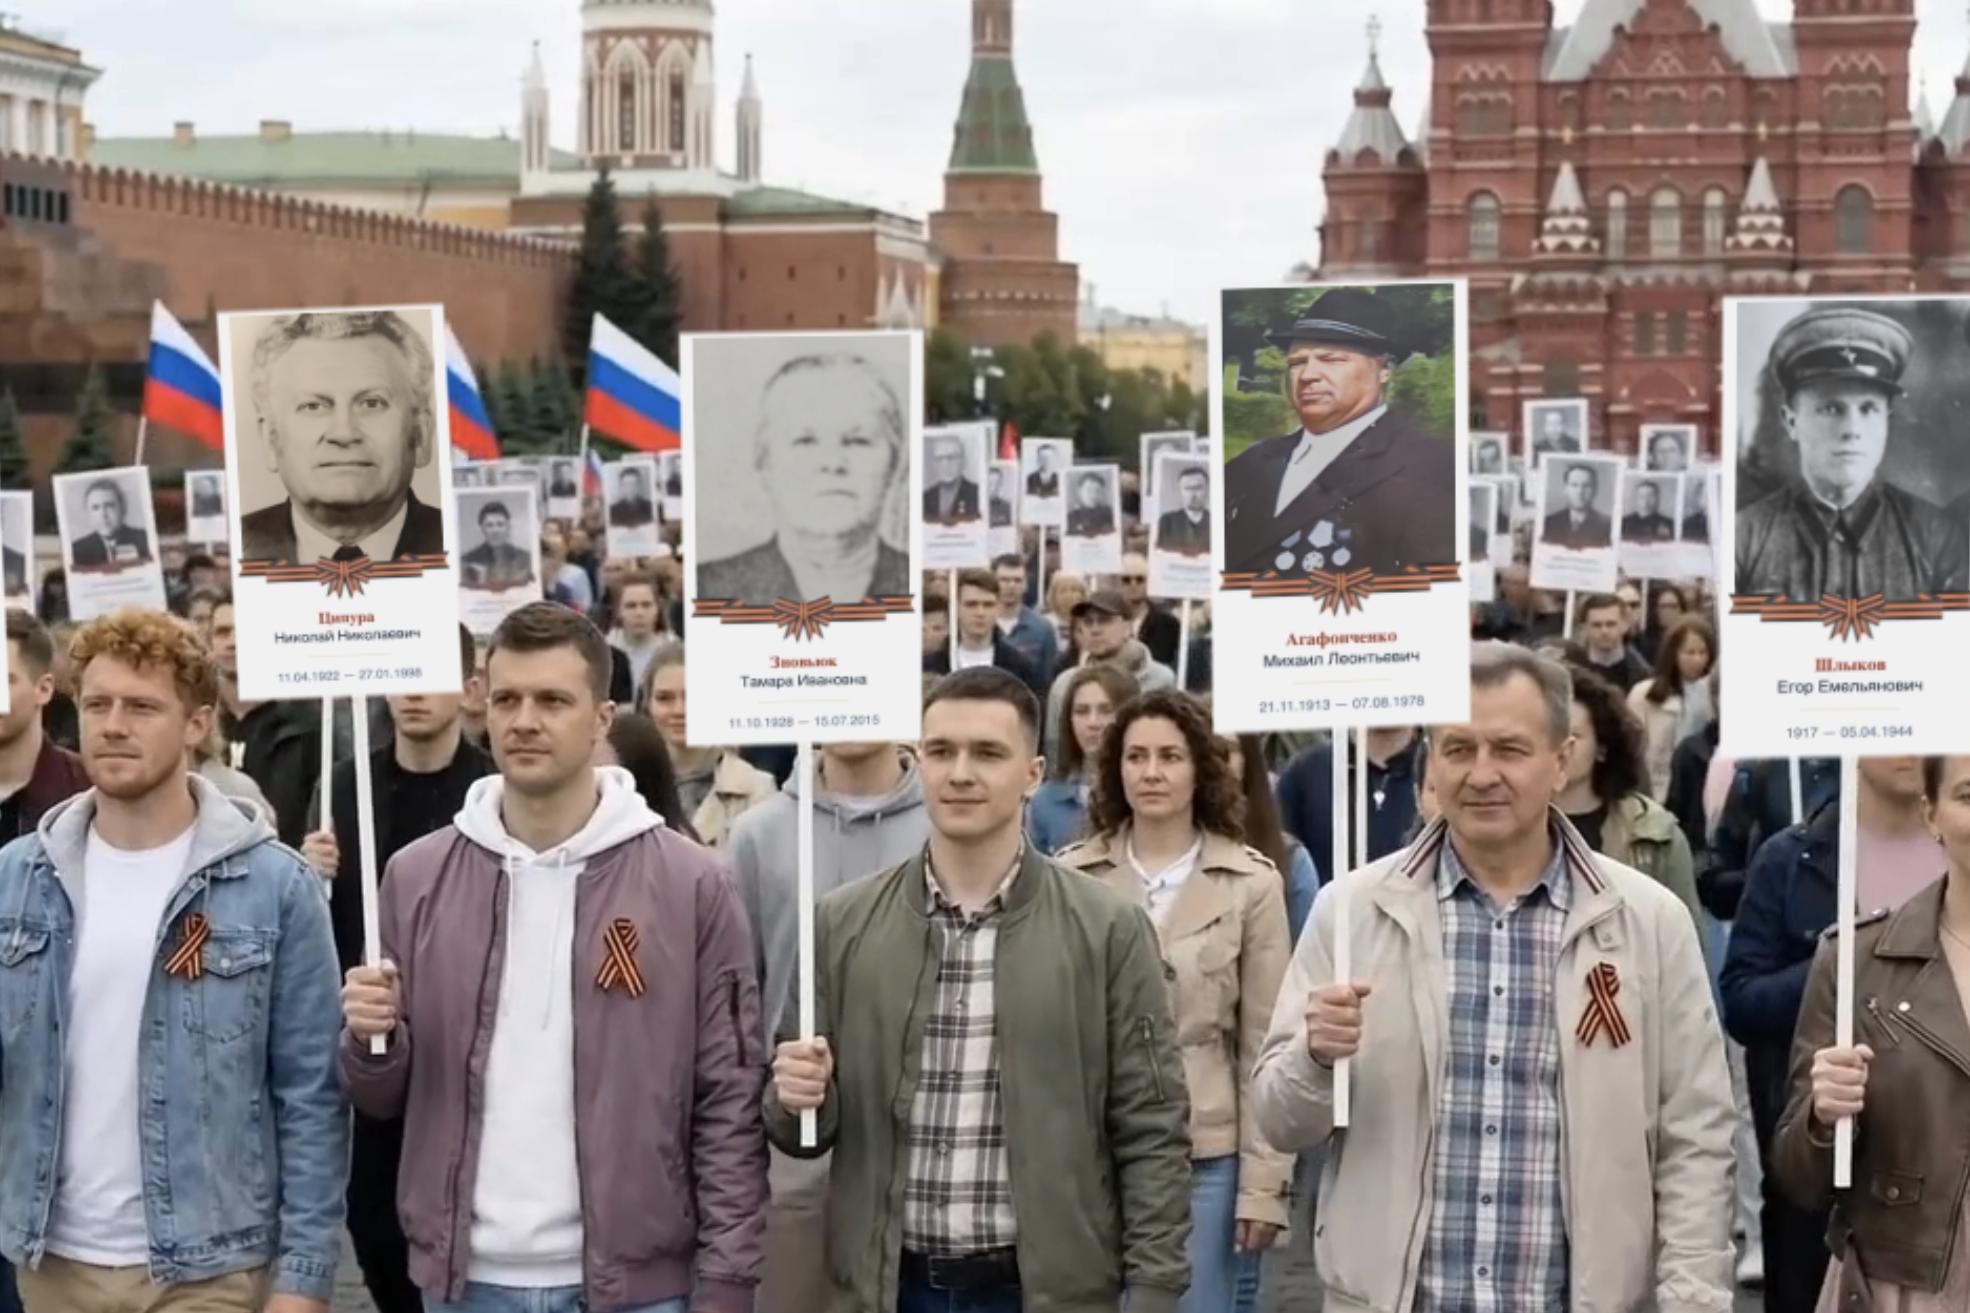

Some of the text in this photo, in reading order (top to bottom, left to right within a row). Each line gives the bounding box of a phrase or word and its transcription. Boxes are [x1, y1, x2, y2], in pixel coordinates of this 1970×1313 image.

[274, 628, 421, 645] Николай Николаевич
[1286, 631, 1398, 650] Агафонченко
[1263, 650, 1421, 669] Михаил Леонтьевич
[1815, 657, 1887, 674] Шлыков
[740, 673, 868, 691] Тамара Ивановна
[1777, 678, 1924, 697] Егор Емельянович
[1259, 698, 1331, 714] 21.11.1913
[1352, 695, 1425, 710] 07.08.1978
[814, 714, 881, 728] 15.07.2015
[1787, 726, 1819, 740] 1917
[1840, 725, 1914, 739] 05.04.1944
